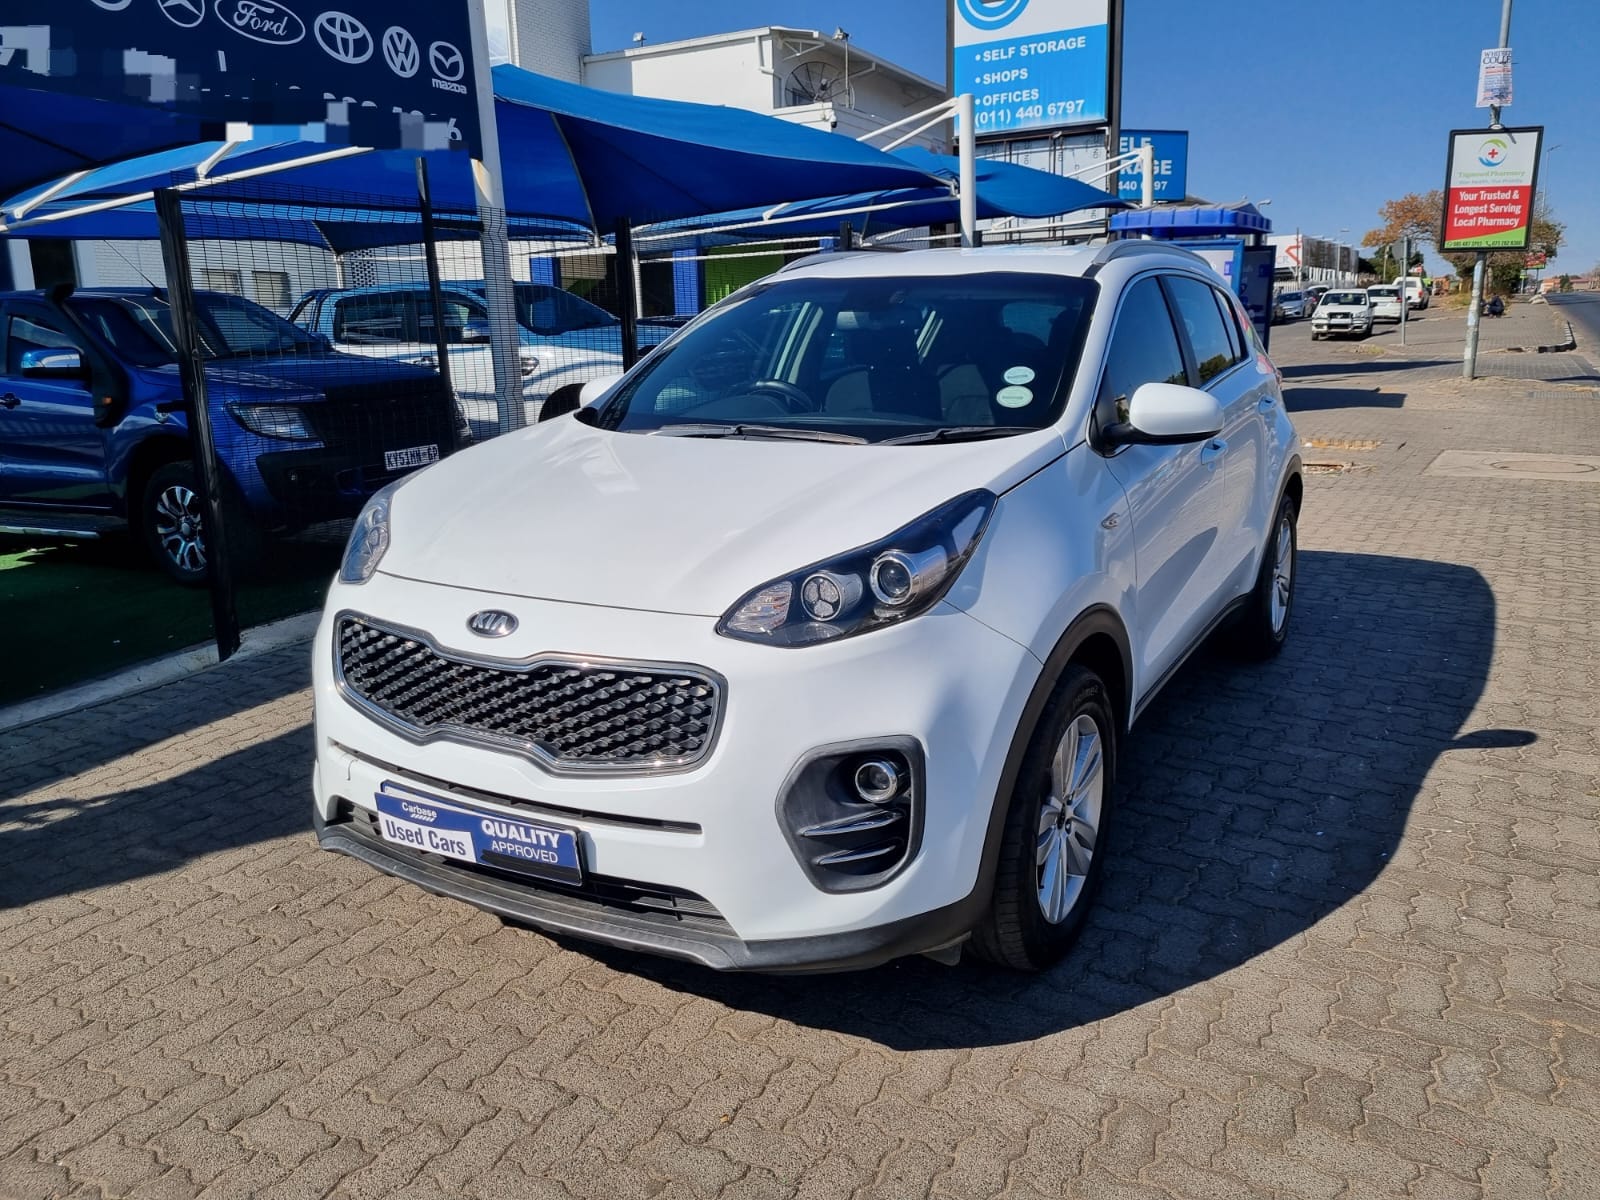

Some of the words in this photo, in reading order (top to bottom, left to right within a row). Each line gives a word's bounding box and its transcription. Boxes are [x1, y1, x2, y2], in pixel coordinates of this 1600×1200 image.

[233, 0, 289, 36] Ford
[983, 46, 1016, 62] SELF
[1020, 36, 1086, 56] STORAGE
[432, 78, 467, 94] mazda
[983, 68, 1028, 85] SHOPS
[982, 88, 1039, 106] OFFICES
[975, 109, 1011, 127] (011)
[1015, 105, 1042, 119] 440
[1047, 100, 1085, 115] 6797
[1459, 191, 1478, 200] Your
[1480, 190, 1511, 200] Trusted
[1512, 189, 1519, 199] &
[1454, 203, 1488, 215] Longest
[1489, 202, 1521, 214] Serving
[1453, 217, 1476, 227] Local
[1477, 216, 1520, 228] Pharmacy
[472, 612, 508, 632] KIA
[402, 802, 437, 818] Carbase
[385, 819, 424, 846] Used
[428, 832, 466, 856] Cars
[481, 819, 560, 848] QUALITY
[491, 840, 558, 863] APPROVED
